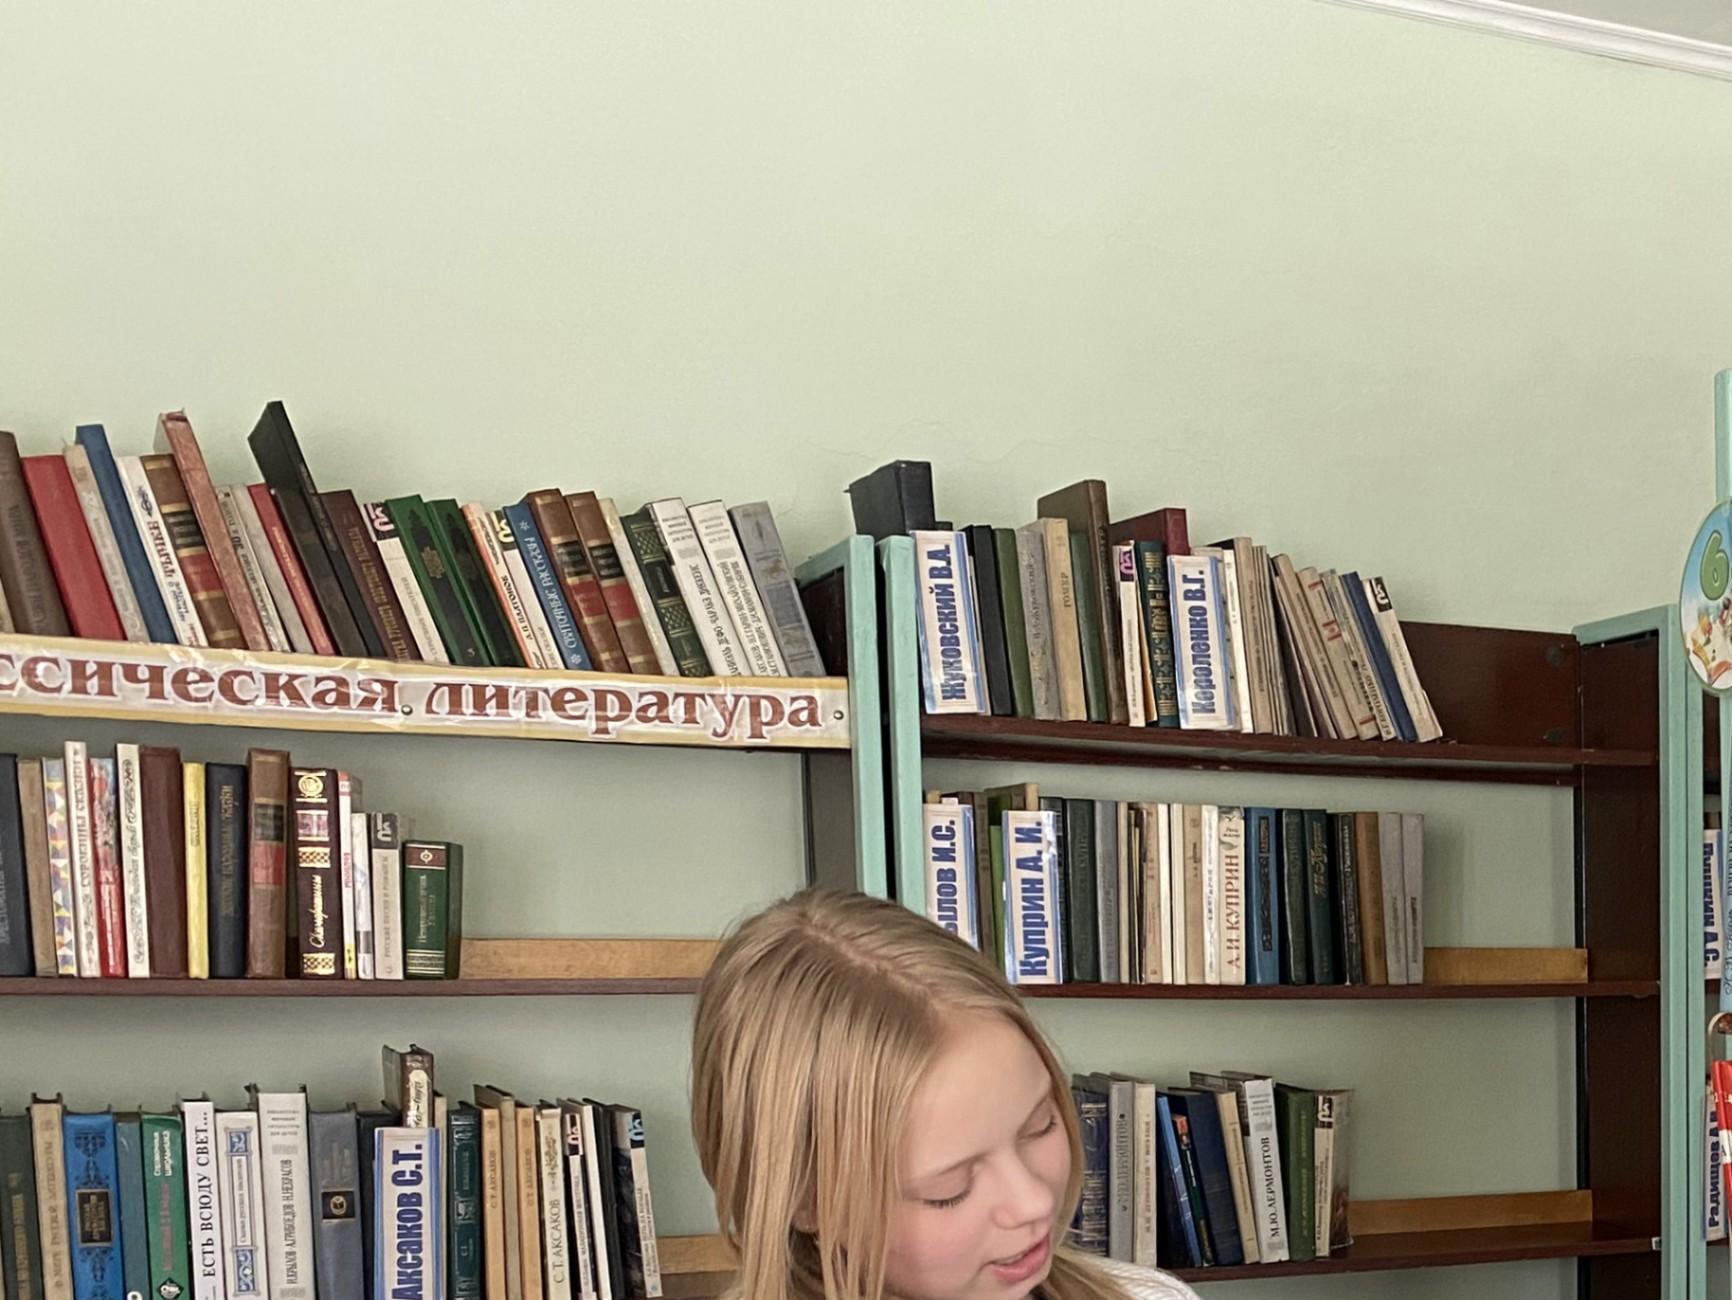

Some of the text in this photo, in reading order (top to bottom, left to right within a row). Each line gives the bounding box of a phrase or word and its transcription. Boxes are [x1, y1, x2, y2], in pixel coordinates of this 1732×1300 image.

[927, 544, 966, 700] Жуковский В.А.
[1182, 570, 1216, 714] Короленко В.Г.
[425, 679, 822, 740] литература
[932, 820, 956, 862] И.С.
[1017, 878, 1049, 976] Куприн
[1224, 854, 1240, 930] КУПРИН
[194, 1112, 216, 1278] ЕСТЬ ВСЮДУ СВЕТ...
[391, 1144, 423, 1300] Аксаков С.Т.
[549, 1199, 563, 1258] АКСАКОВ
